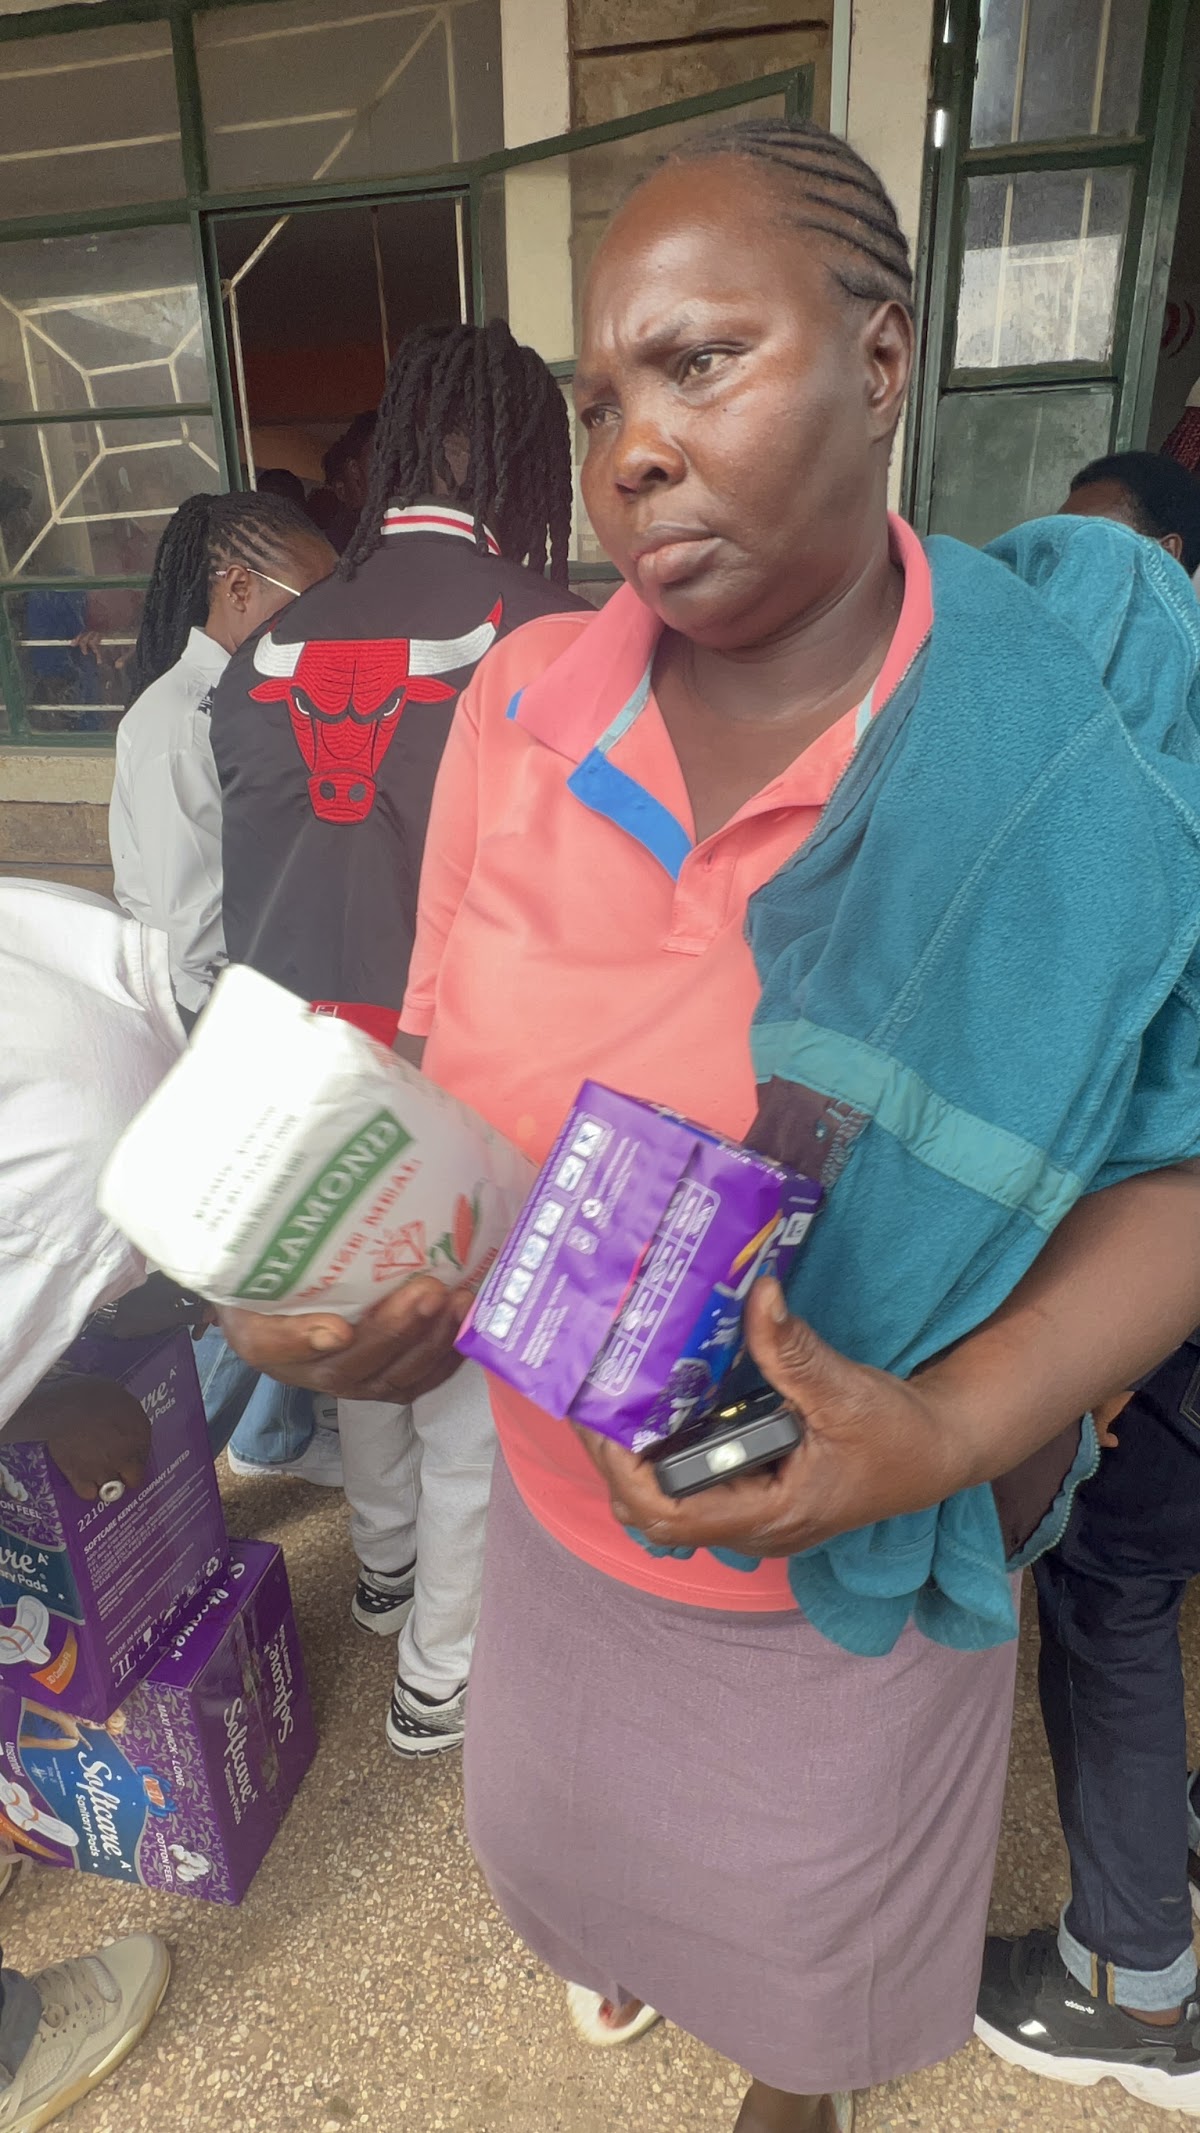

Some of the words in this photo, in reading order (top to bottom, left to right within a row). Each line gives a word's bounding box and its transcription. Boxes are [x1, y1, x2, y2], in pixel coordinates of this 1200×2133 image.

[249, 1117, 402, 1297] DIAMOND
[155, 1397, 176, 1418] Pads
[16, 1504, 42, 1519] FEEL
[84, 1518, 117, 1554] SOFTCARE
[117, 1499, 138, 1525] KENYA
[138, 1471, 166, 1501] COMPANY
[166, 1450, 190, 1474] LIMITED
[18, 1573, 49, 1593] Pads
[109, 1640, 126, 1663] MADE
[126, 1633, 133, 1644] IN
[133, 1613, 151, 1636] KENYA
[52, 1657, 67, 1680] Comfort
[269, 1643, 294, 1744] Softcare
[5, 1741, 25, 1777] Unscented
[156, 1703, 170, 1731] MAXI
[164, 1731, 178, 1758] THICK
[172, 1760, 185, 1787] LONG
[224, 1697, 252, 1803] Softcare
[75, 1793, 91, 1832] Sanitary
[86, 1831, 100, 1857] Pads
[76, 1751, 122, 1857] Softcare
[156, 1832, 169, 1864] COTTON
[164, 1863, 173, 1883] FEEL
